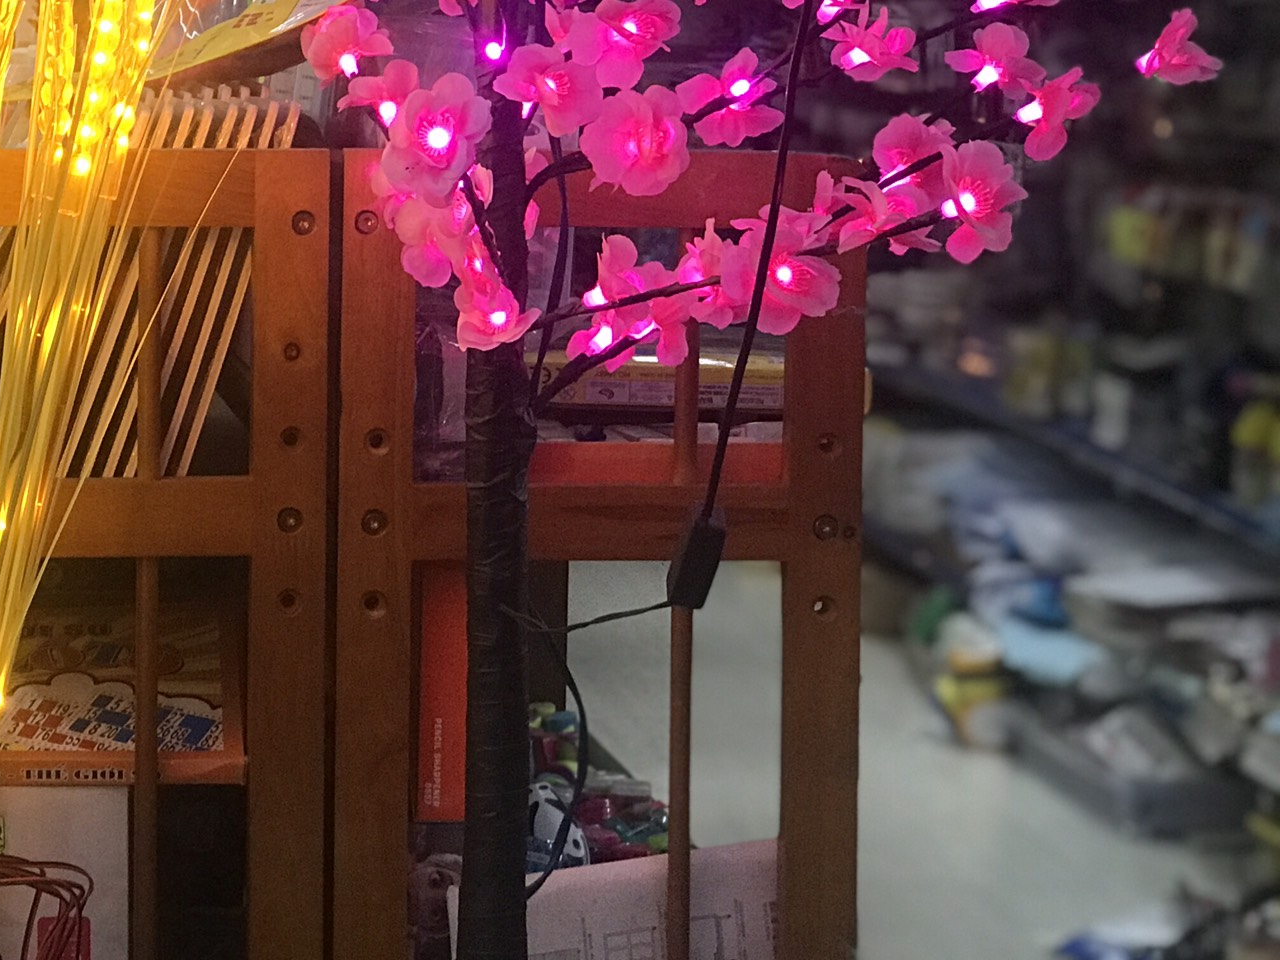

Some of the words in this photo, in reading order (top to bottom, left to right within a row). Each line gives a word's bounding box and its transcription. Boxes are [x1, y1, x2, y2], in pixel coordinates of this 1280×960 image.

[7, 722, 20, 734] 3
[89, 723, 102, 736] 8
[100, 725, 118, 739] 20
[434, 717, 442, 750] PENCIL
[200, 734, 219, 748] 83
[432, 753, 442, 808] SHARPENER
